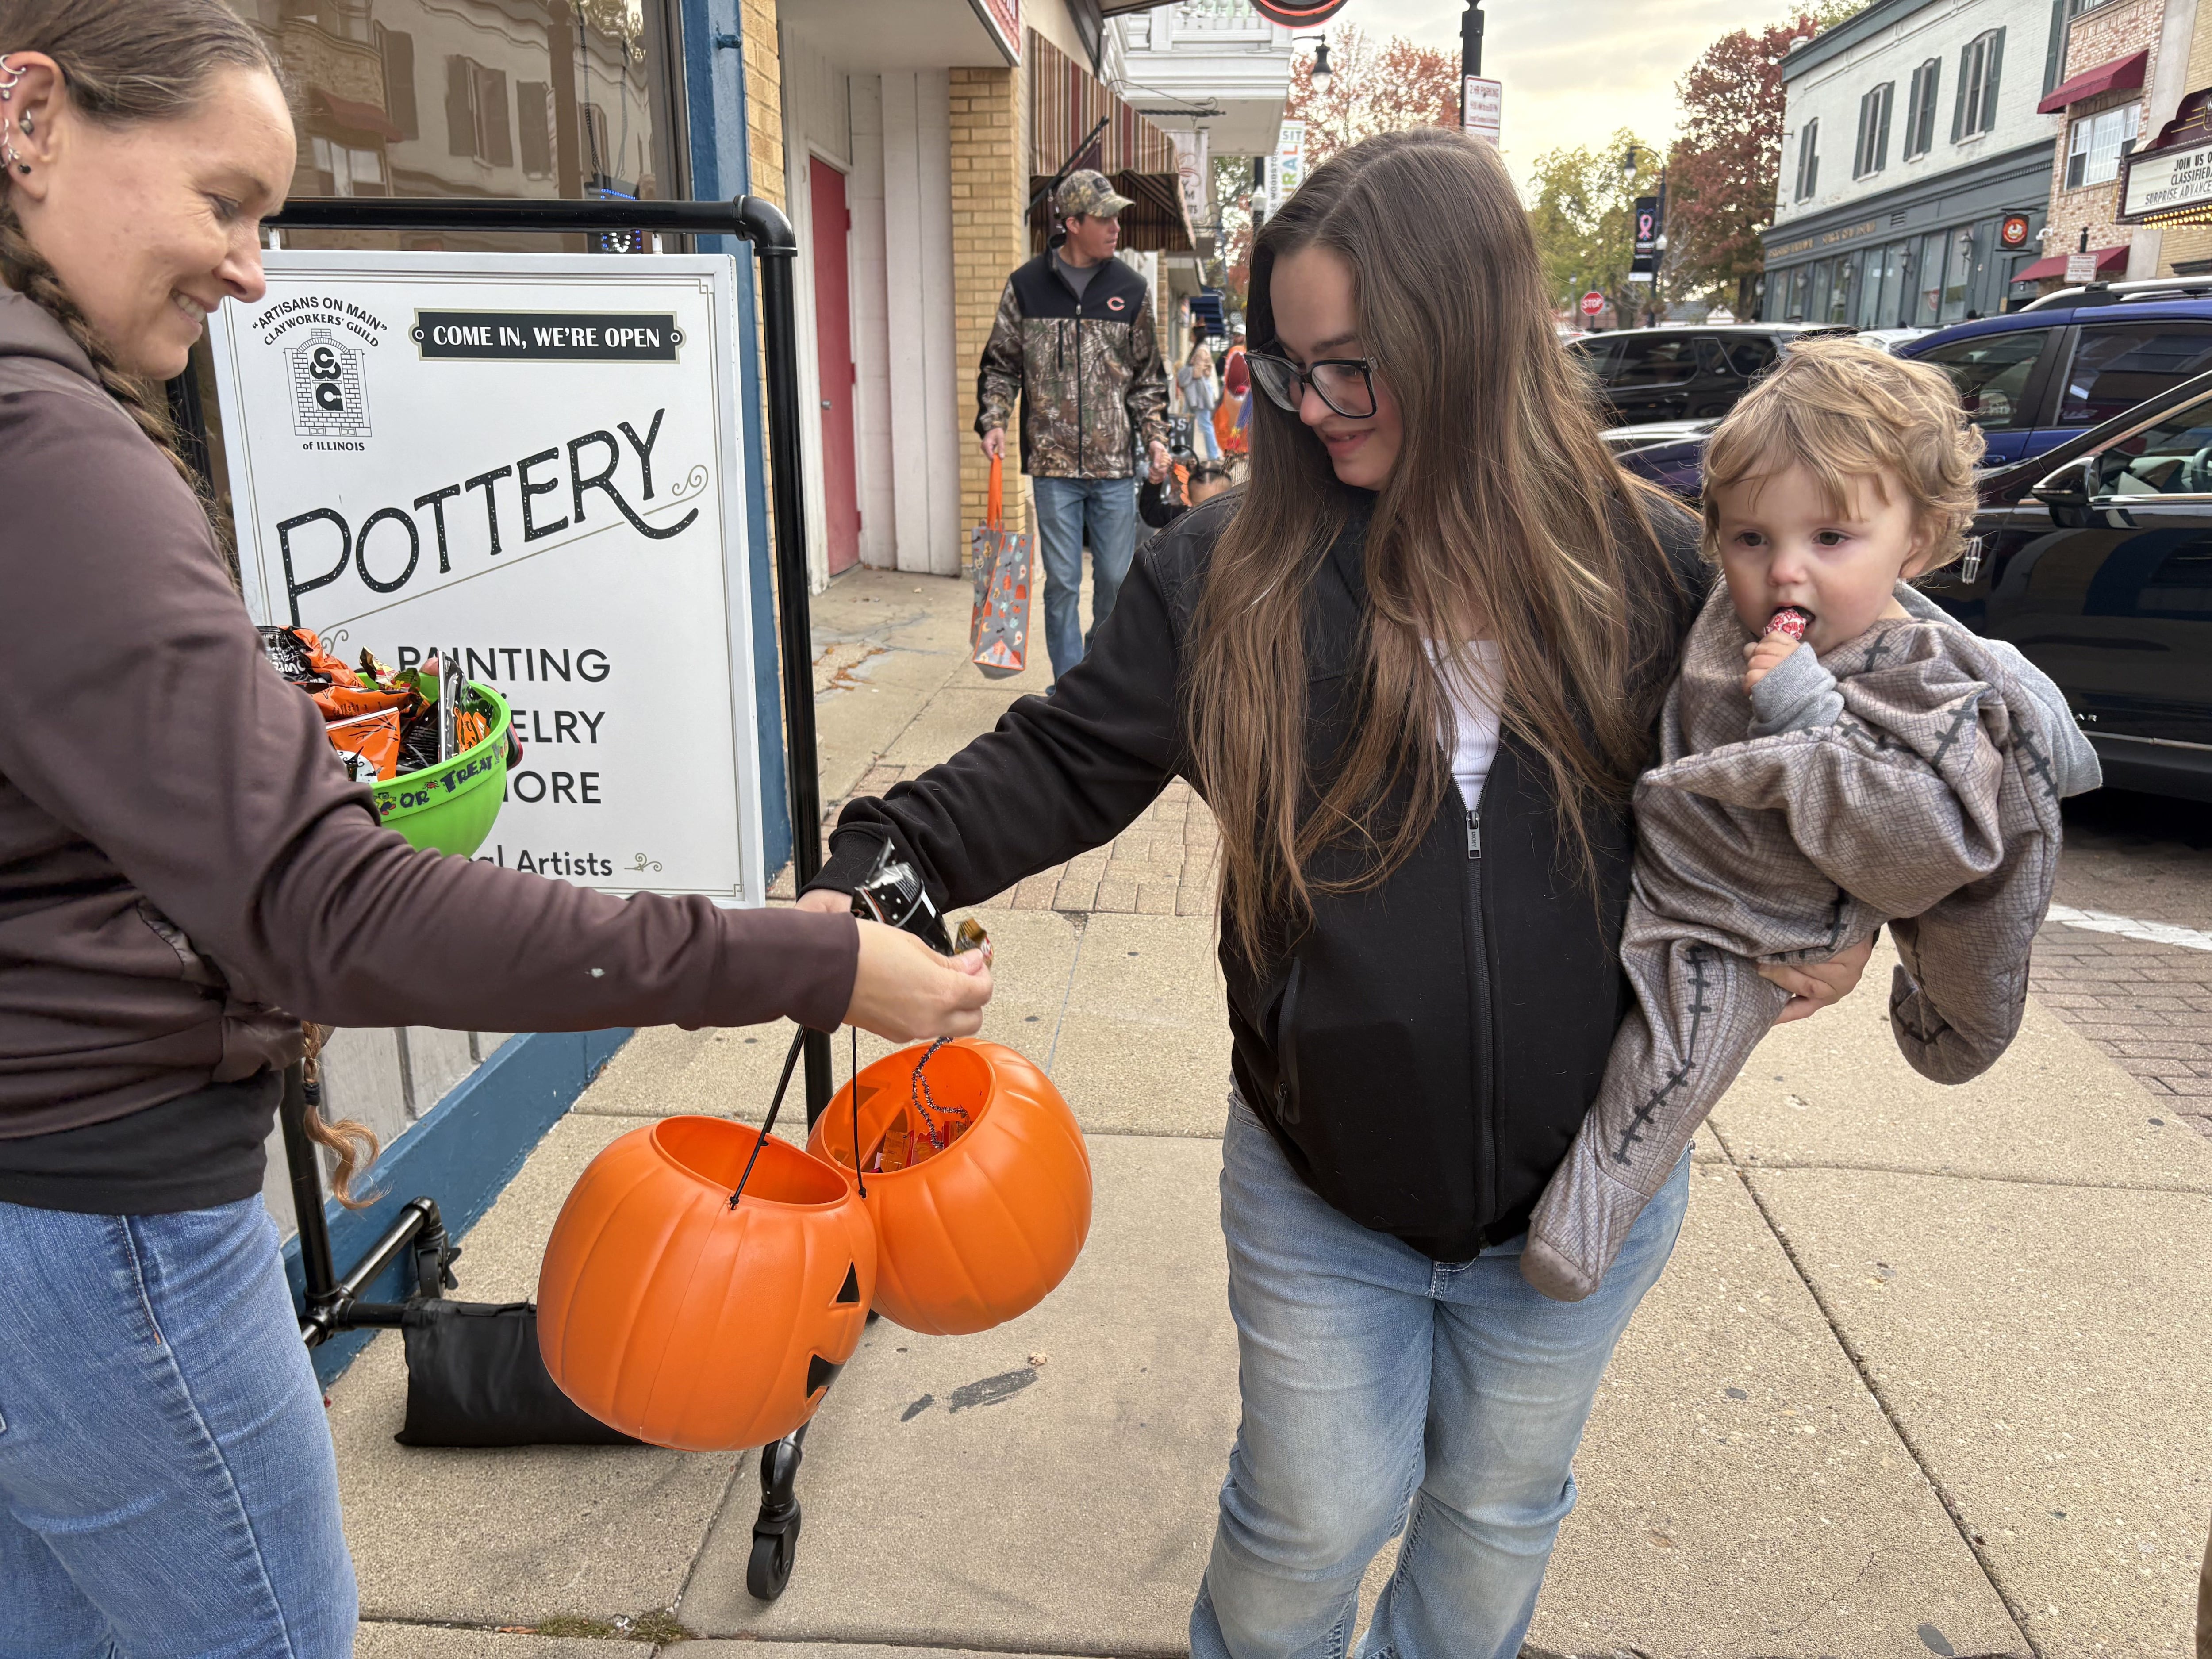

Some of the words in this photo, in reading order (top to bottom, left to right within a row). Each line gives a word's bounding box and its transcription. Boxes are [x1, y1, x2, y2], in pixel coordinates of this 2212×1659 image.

[1283, 131, 1302, 141] SIT
[2174, 157, 2191, 171] JOIN
[2195, 154, 2204, 166] US
[2208, 151, 2212, 163] O
[1282, 145, 1298, 199] RAL
[2171, 166, 2212, 186] CLASSIFIED
[2145, 188, 2178, 205] SURPRISE
[2179, 180, 2212, 198] ADVANCE
[323, 297, 343, 311] ON
[1107, 296, 1125, 311] C
[1582, 298, 1602, 309] STOP
[346, 322, 379, 347] GUILD
[433, 326, 493, 346] COME
[499, 326, 527, 349] IN,
[533, 327, 599, 347] WE'RE
[604, 328, 660, 348] OPEN
[303, 441, 313, 450] of
[317, 442, 365, 451] ILLINOIS
[276, 408, 699, 626] POTTERY
[511, 710, 605, 744] ELRY
[503, 771, 601, 804] ORE
[400, 790, 430, 808] OR
[518, 850, 613, 876] Artists
